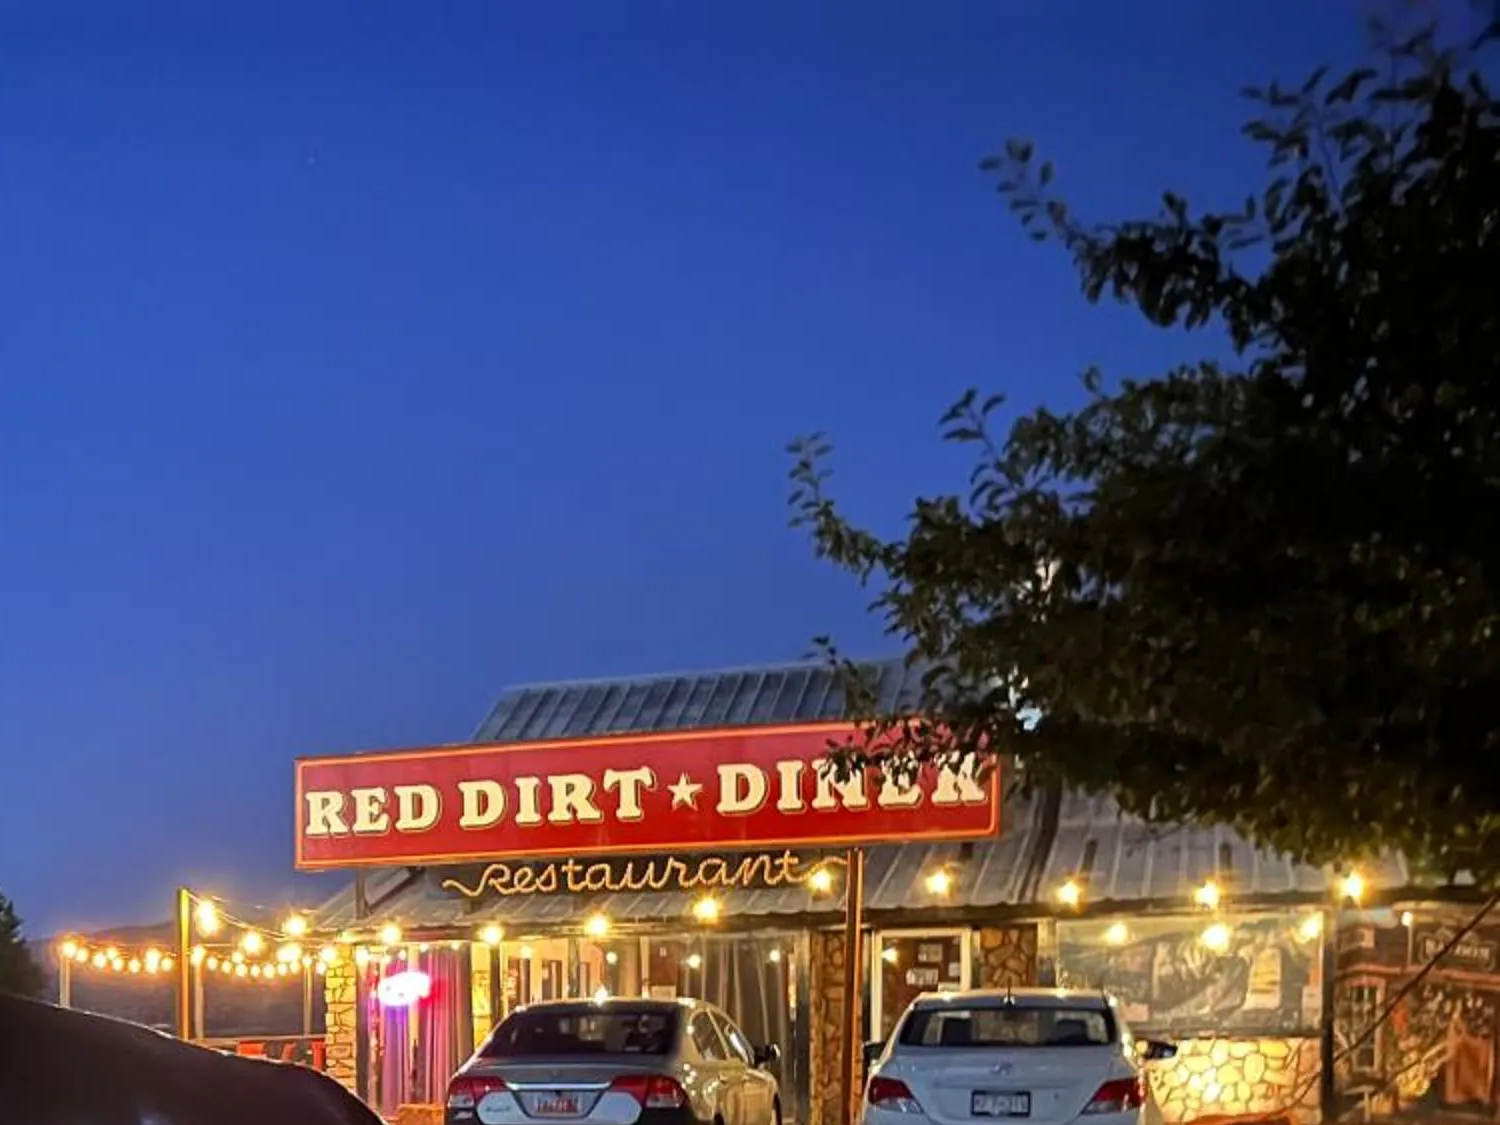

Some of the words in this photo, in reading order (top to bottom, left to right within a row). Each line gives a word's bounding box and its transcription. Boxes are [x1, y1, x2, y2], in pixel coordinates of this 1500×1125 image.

[304, 784, 442, 836] RED
[458, 766, 656, 829] DIRT
[445, 849, 843, 897] Restaurant
